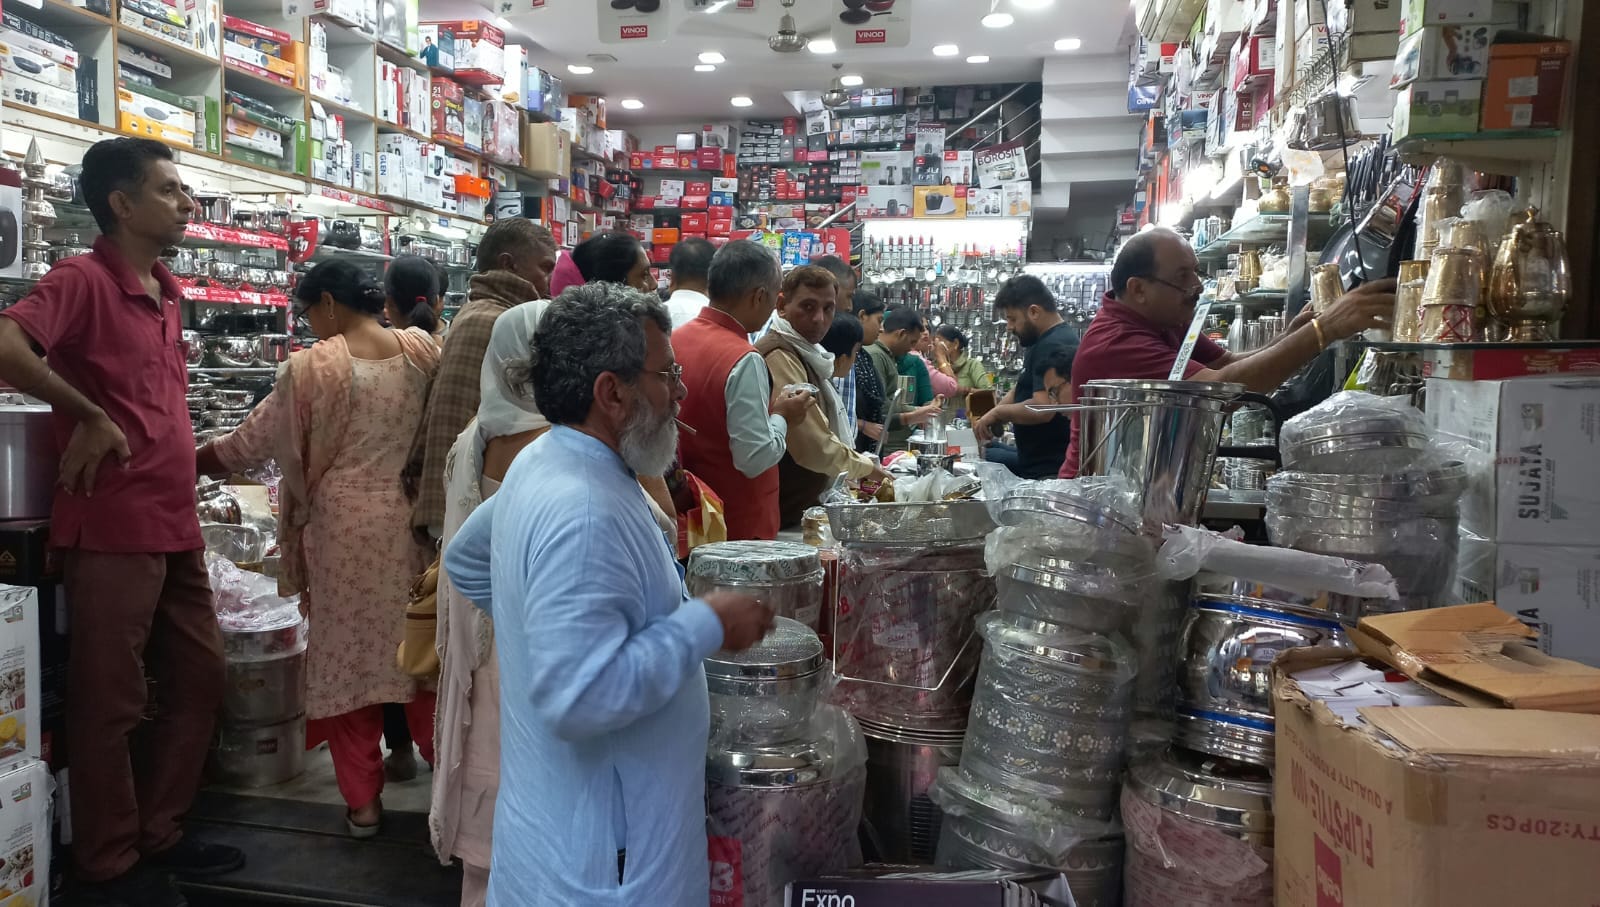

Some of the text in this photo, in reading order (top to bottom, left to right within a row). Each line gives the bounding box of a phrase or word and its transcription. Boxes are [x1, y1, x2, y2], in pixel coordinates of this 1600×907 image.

[433, 86, 441, 95] 51
[977, 148, 1021, 166] BOROSIL
[240, 232, 261, 241] VINOD
[183, 286, 206, 296] VINOD
[1339, 775, 1383, 809] QUALITY
[1385, 800, 1393, 816] A
[1309, 777, 1375, 870] FLIPSTYLE
[801, 888, 855, 907] Expo
